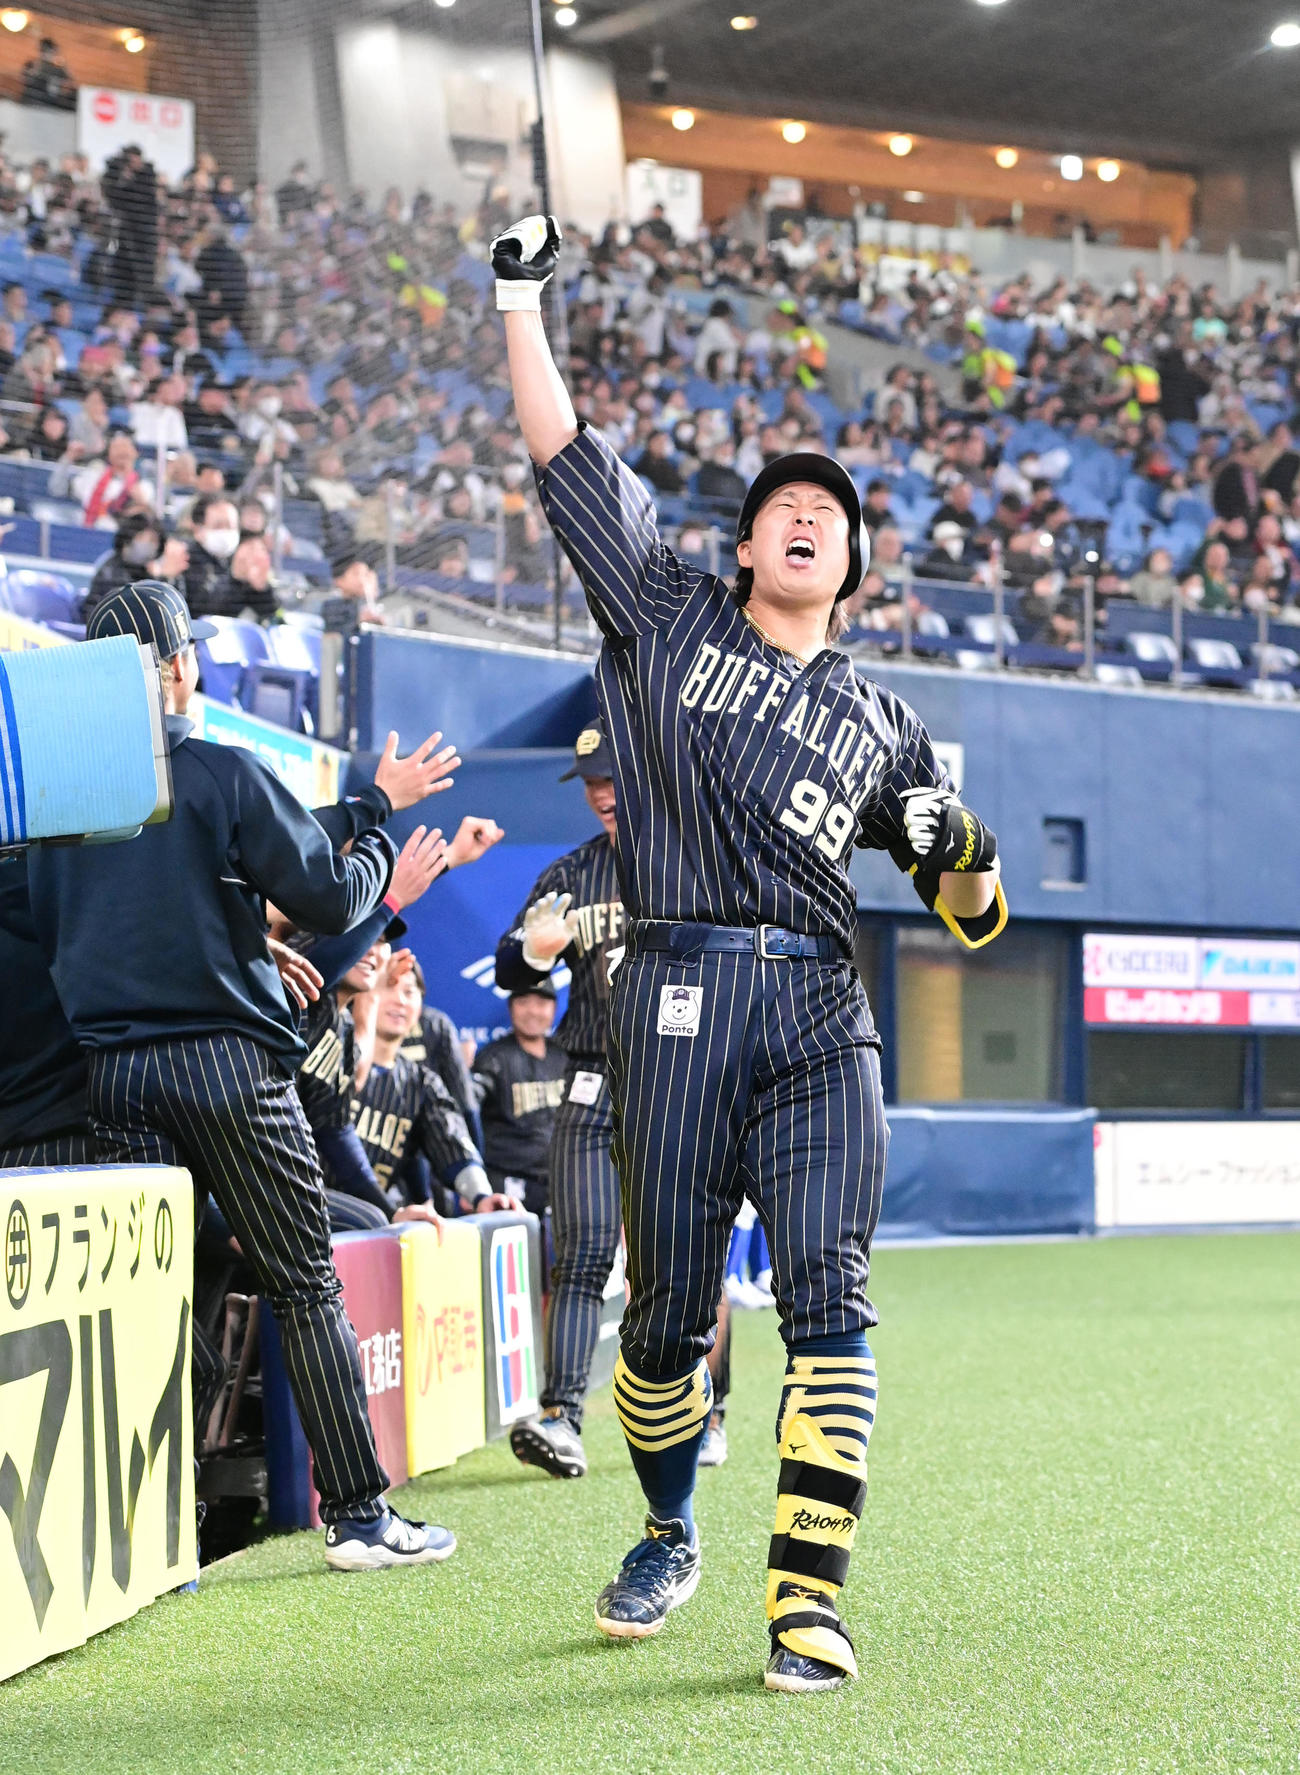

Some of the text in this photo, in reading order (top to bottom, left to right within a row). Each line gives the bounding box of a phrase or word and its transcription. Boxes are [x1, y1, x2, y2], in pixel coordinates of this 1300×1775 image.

[681, 642, 885, 813] BUFFALOES
[779, 779, 854, 861] 99
[661, 1024, 695, 1035] Ponta
[326, 1525, 337, 1543] 6
